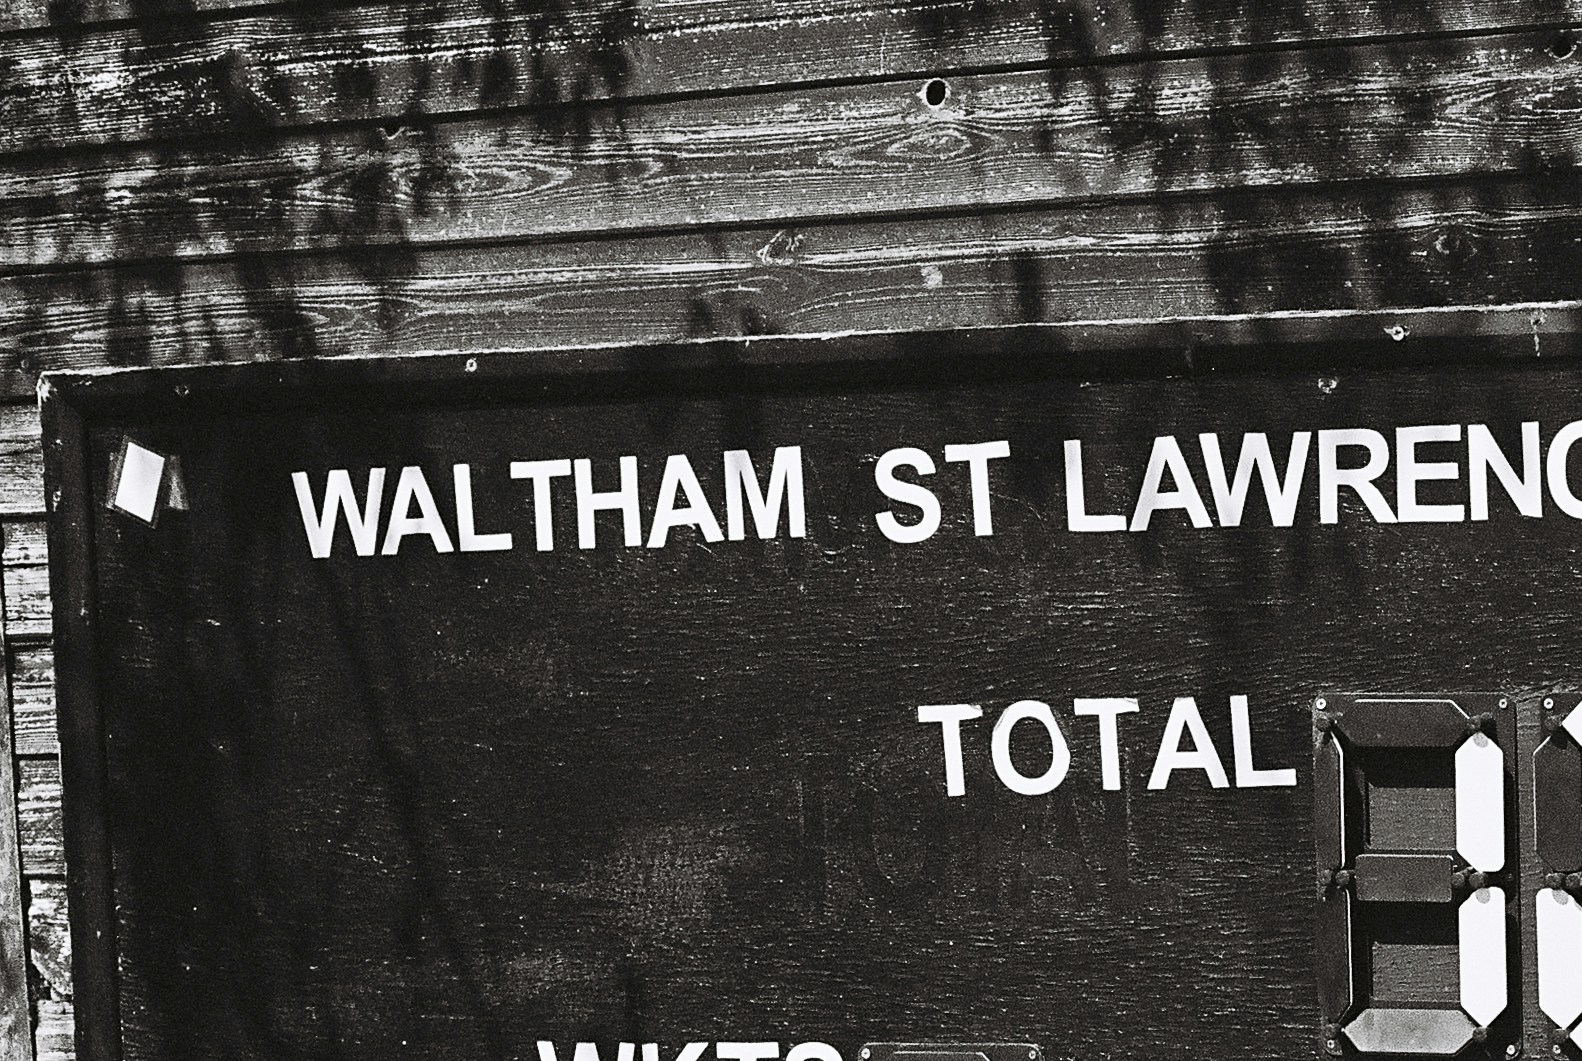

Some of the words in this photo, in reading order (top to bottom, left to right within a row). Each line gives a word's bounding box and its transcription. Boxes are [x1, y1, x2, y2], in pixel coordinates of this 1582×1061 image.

[291, 445, 806, 559] WALTHAM
[875, 439, 1011, 544] ST
[917, 694, 1297, 797] TOTAL
